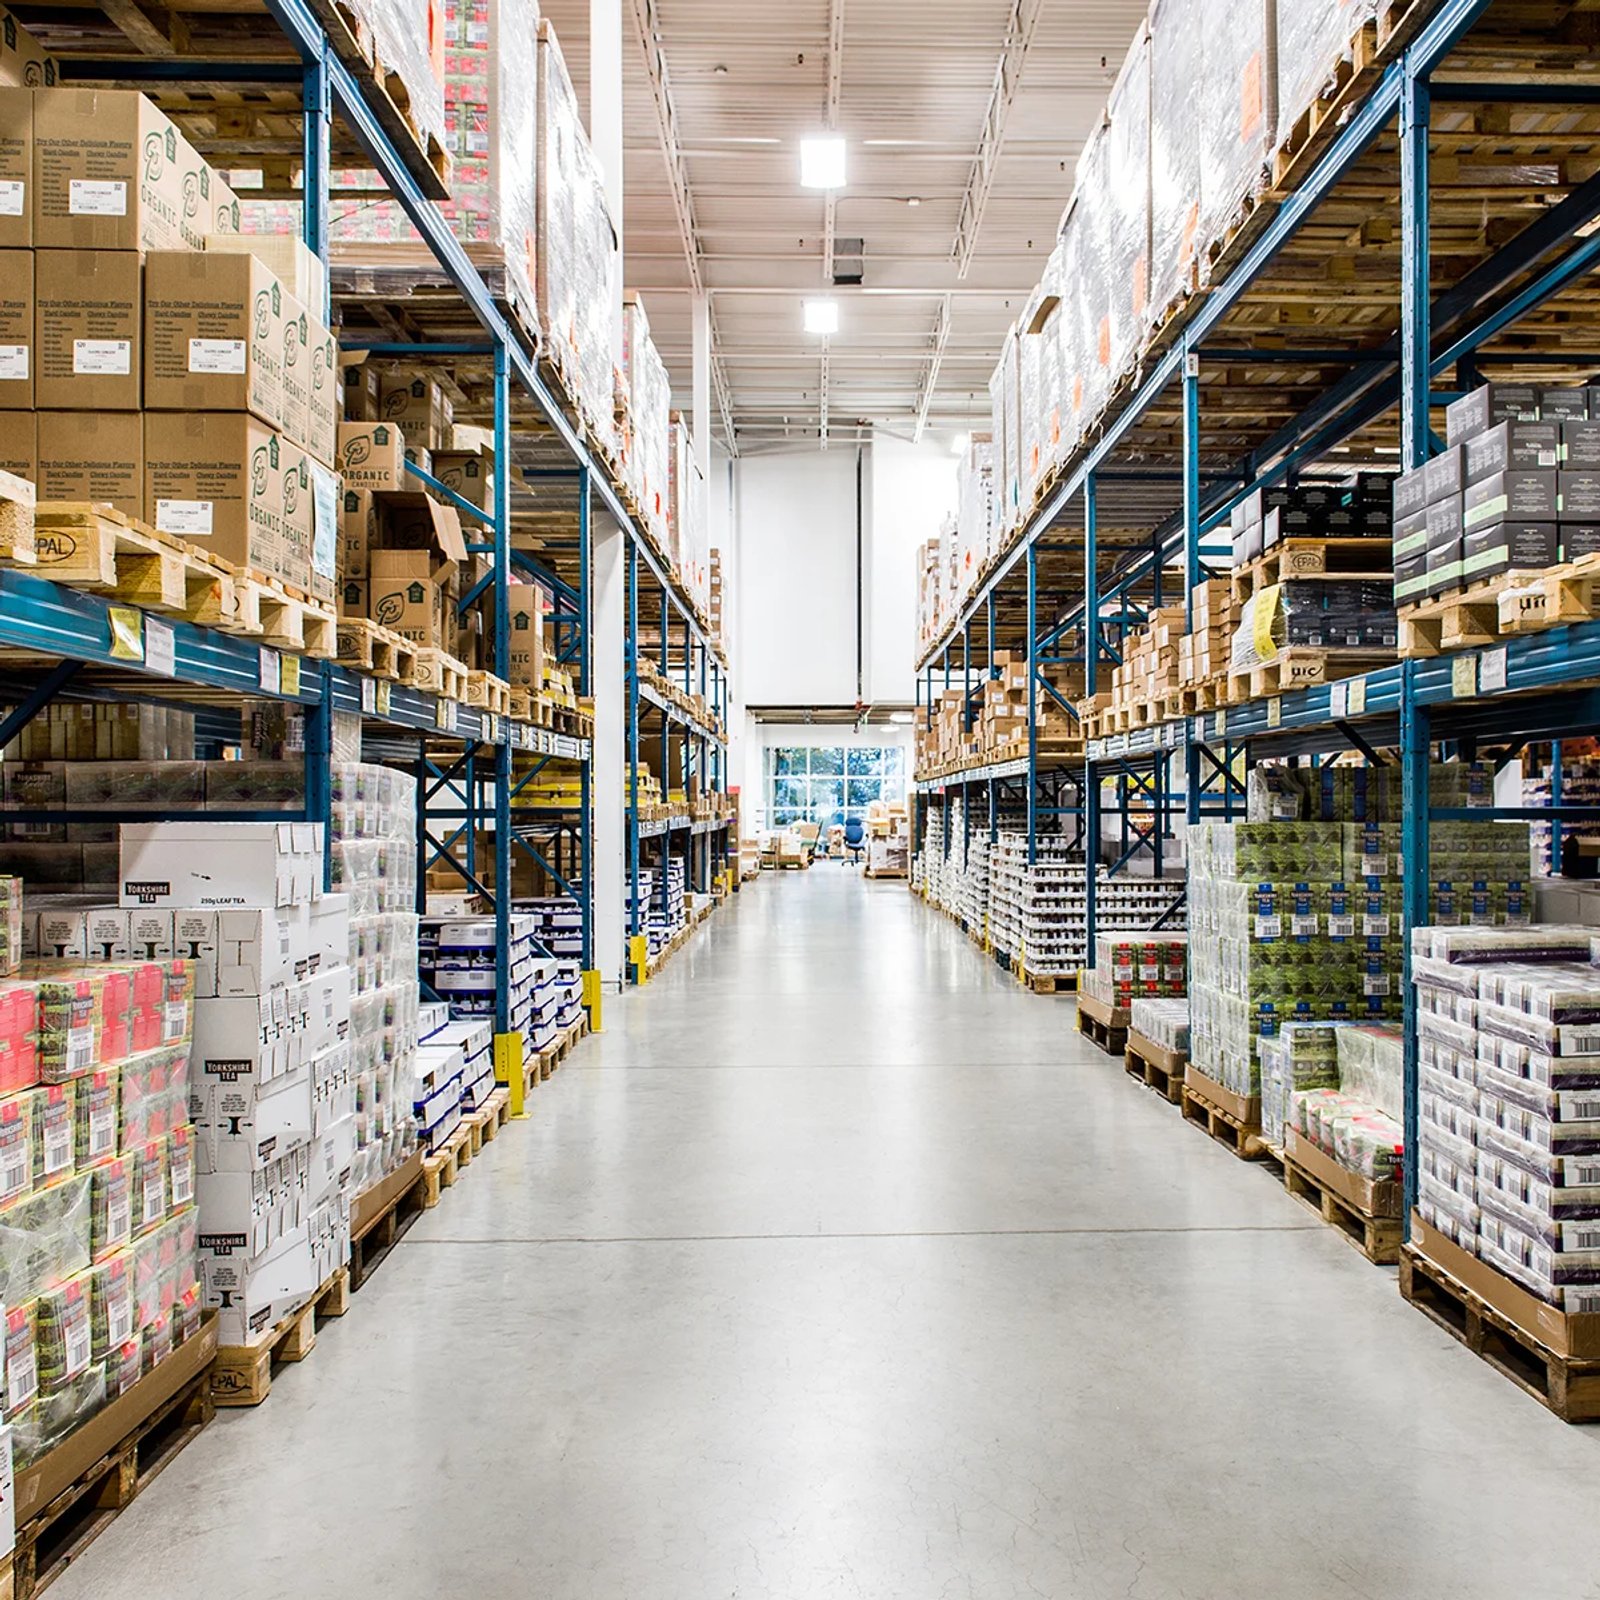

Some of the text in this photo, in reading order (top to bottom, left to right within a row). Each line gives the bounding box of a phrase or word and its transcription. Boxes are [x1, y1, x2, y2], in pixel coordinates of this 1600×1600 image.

[142, 184, 176, 228] ORGANIC
[341, 469, 390, 481] ORGANIC
[250, 502, 280, 533] ORGANIC
[282, 521, 308, 550] ORGANIC
[36, 538, 67, 555] PAL
[127, 885, 168, 894] YORKSHIRE
[141, 894, 156, 903] TEA
[201, 897, 216, 905] 250g
[206, 1062, 251, 1072] YORKSHIRE
[221, 1072, 237, 1080] TEA
[200, 1237, 246, 1247] YORKSHIRE
[215, 1246, 232, 1254] TEA
